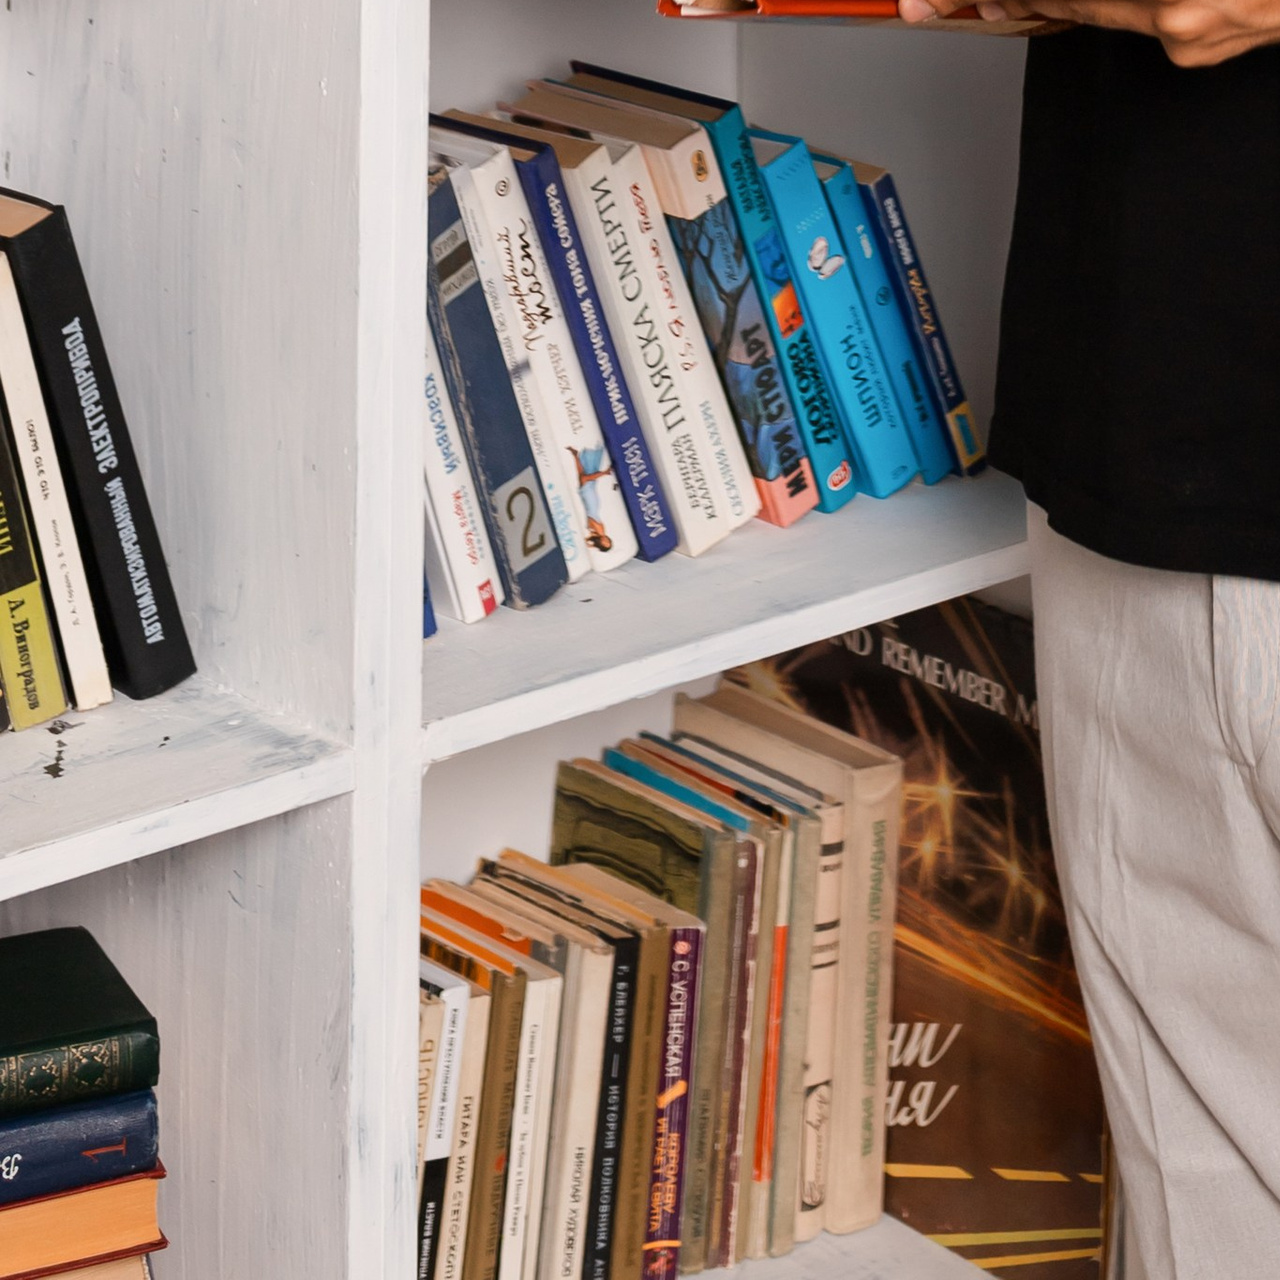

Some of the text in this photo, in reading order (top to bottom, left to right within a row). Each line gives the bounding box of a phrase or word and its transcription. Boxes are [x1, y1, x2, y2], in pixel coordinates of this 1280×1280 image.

[589, 175, 687, 434] ПЛЯСКА СМЕРТИ
[740, 321, 787, 424] СТЮАРТ
[33, 454, 47, 477] ЭТО
[36, 478, 50, 501] ЧТО
[61, 315, 166, 645] АВТОМАТИЗИРОВАННЫЙ ЭЛЕКТРОПРИВОД
[505, 486, 546, 557] 2
[13, 620, 40, 711] Виноградов
[830, 627, 873, 656] ND
[881, 636, 1008, 716] REMEMBER
[664, 979, 689, 1078] УСПЕНСКАЯ
[457, 1095, 474, 1149] ГИТАРА
[569, 1145, 586, 1204] НИКОЛАЙ
[595, 1084, 620, 1252] ИСТОРИЯ ПОЛКОВНИКА
